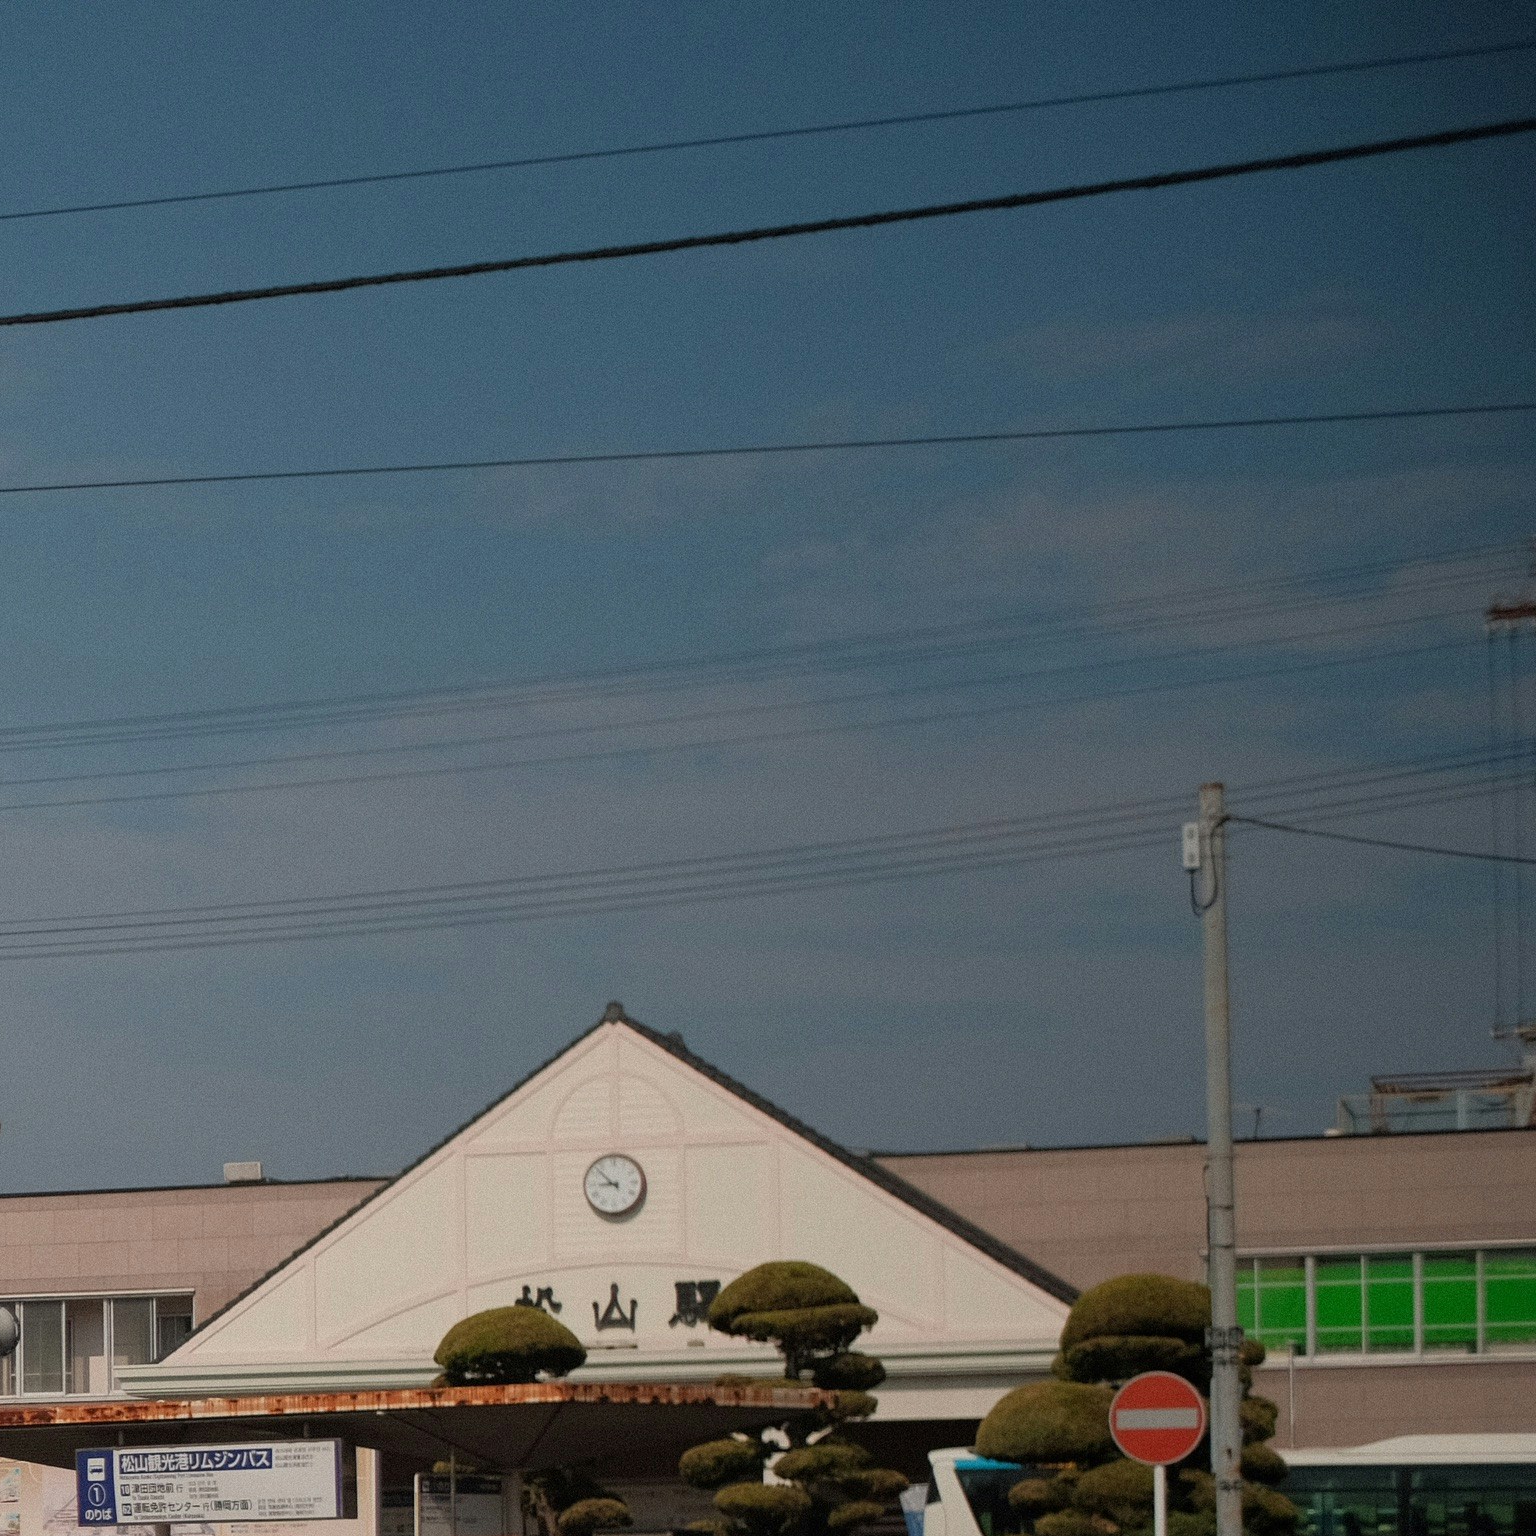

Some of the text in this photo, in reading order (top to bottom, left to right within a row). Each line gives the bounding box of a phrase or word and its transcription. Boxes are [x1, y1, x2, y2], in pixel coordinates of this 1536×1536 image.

[121, 1450, 270, 1472] 松山観光港リムジンバス
[85, 1508, 113, 1521] のりば
